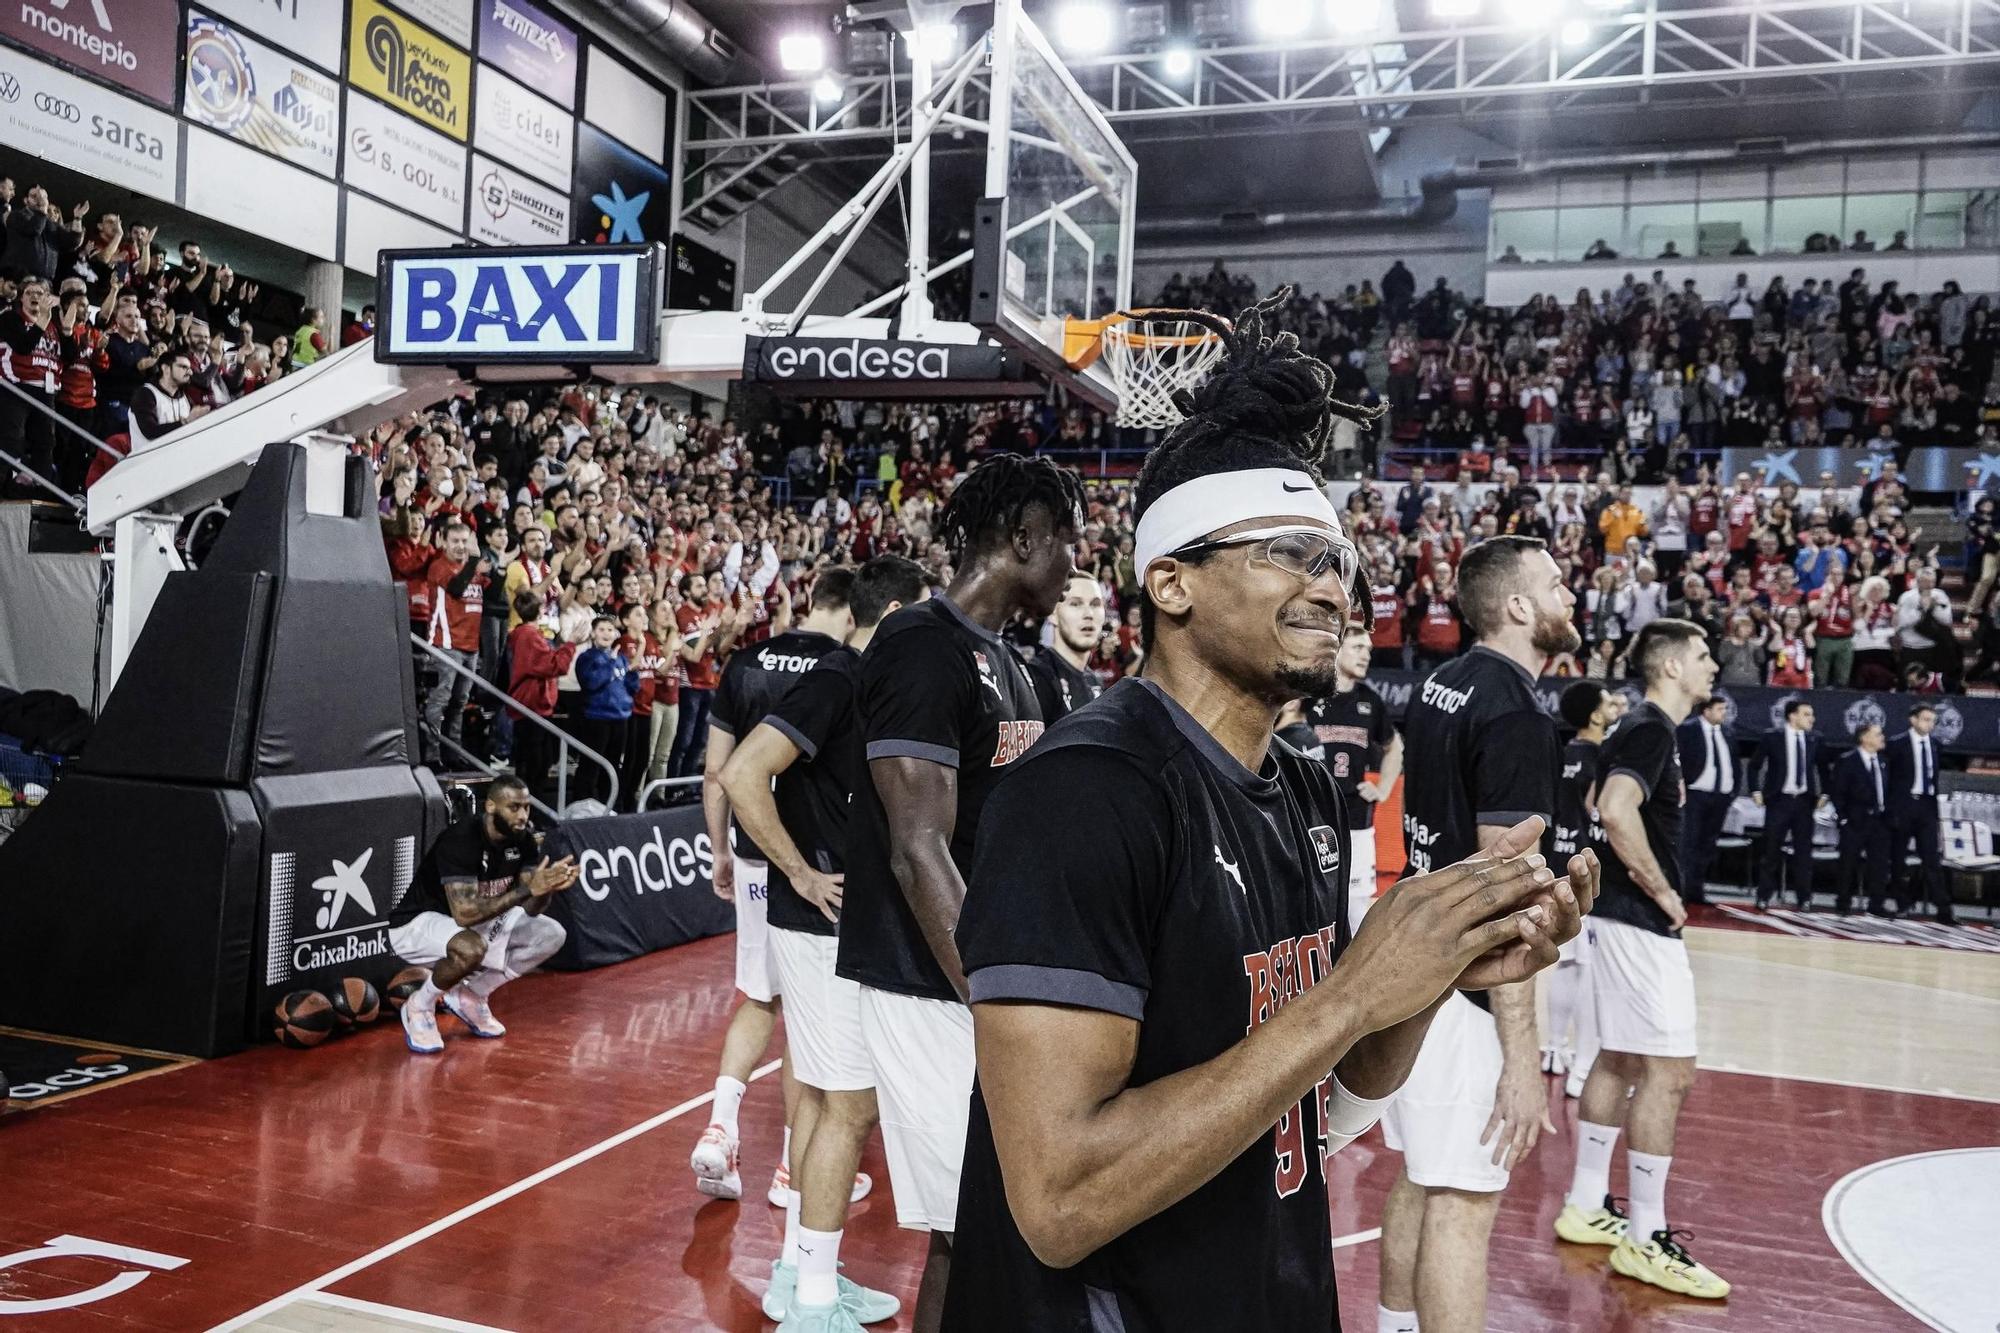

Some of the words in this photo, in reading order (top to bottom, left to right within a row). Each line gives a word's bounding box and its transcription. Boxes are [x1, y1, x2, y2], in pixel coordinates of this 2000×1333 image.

[21, 3, 137, 71] montepio
[91, 115, 163, 160] sarsa
[403, 162, 438, 193] GOL
[406, 263, 620, 342] BAXI
[771, 339, 949, 379] endesa
[579, 826, 737, 901] endes
[293, 929, 388, 971] CaixaBank
